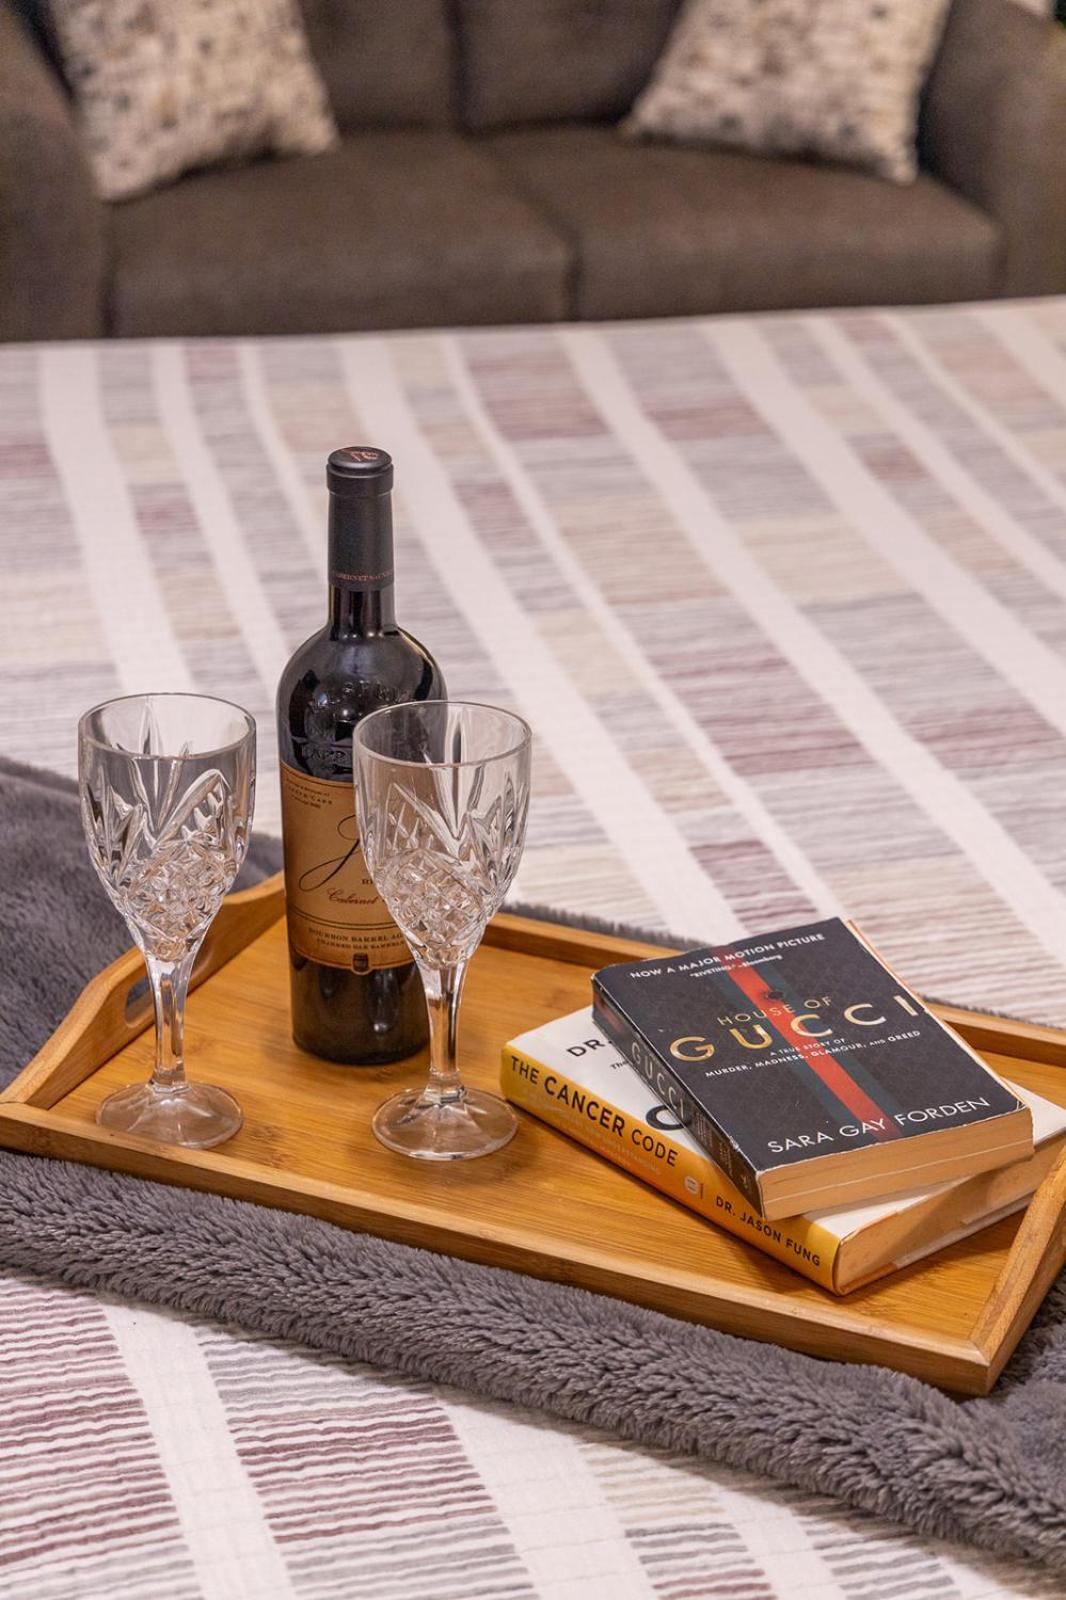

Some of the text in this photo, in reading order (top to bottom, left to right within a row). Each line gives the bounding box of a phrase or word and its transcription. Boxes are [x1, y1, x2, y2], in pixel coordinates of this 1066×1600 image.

[630, 933, 826, 979] NOW A MAJOR MOTION PICTURE
[670, 995, 919, 1062] GUCCI
[717, 996, 832, 1026] HOUSE OF
[705, 1030, 921, 1078] MURDER, MADNESS, GLAMOUR, AND GREED
[779, 1046, 801, 1055] TRUE
[803, 1041, 831, 1050] STORY
[834, 1037, 846, 1045] OF
[631, 1042, 685, 1120] GUCCI
[511, 1056, 540, 1084] THE
[544, 1076, 625, 1137] CANCER
[631, 1129, 678, 1167] CODE
[767, 1096, 991, 1153] SARA GAY FORDEN
[716, 1195, 821, 1267] DR. JASON FUNG
